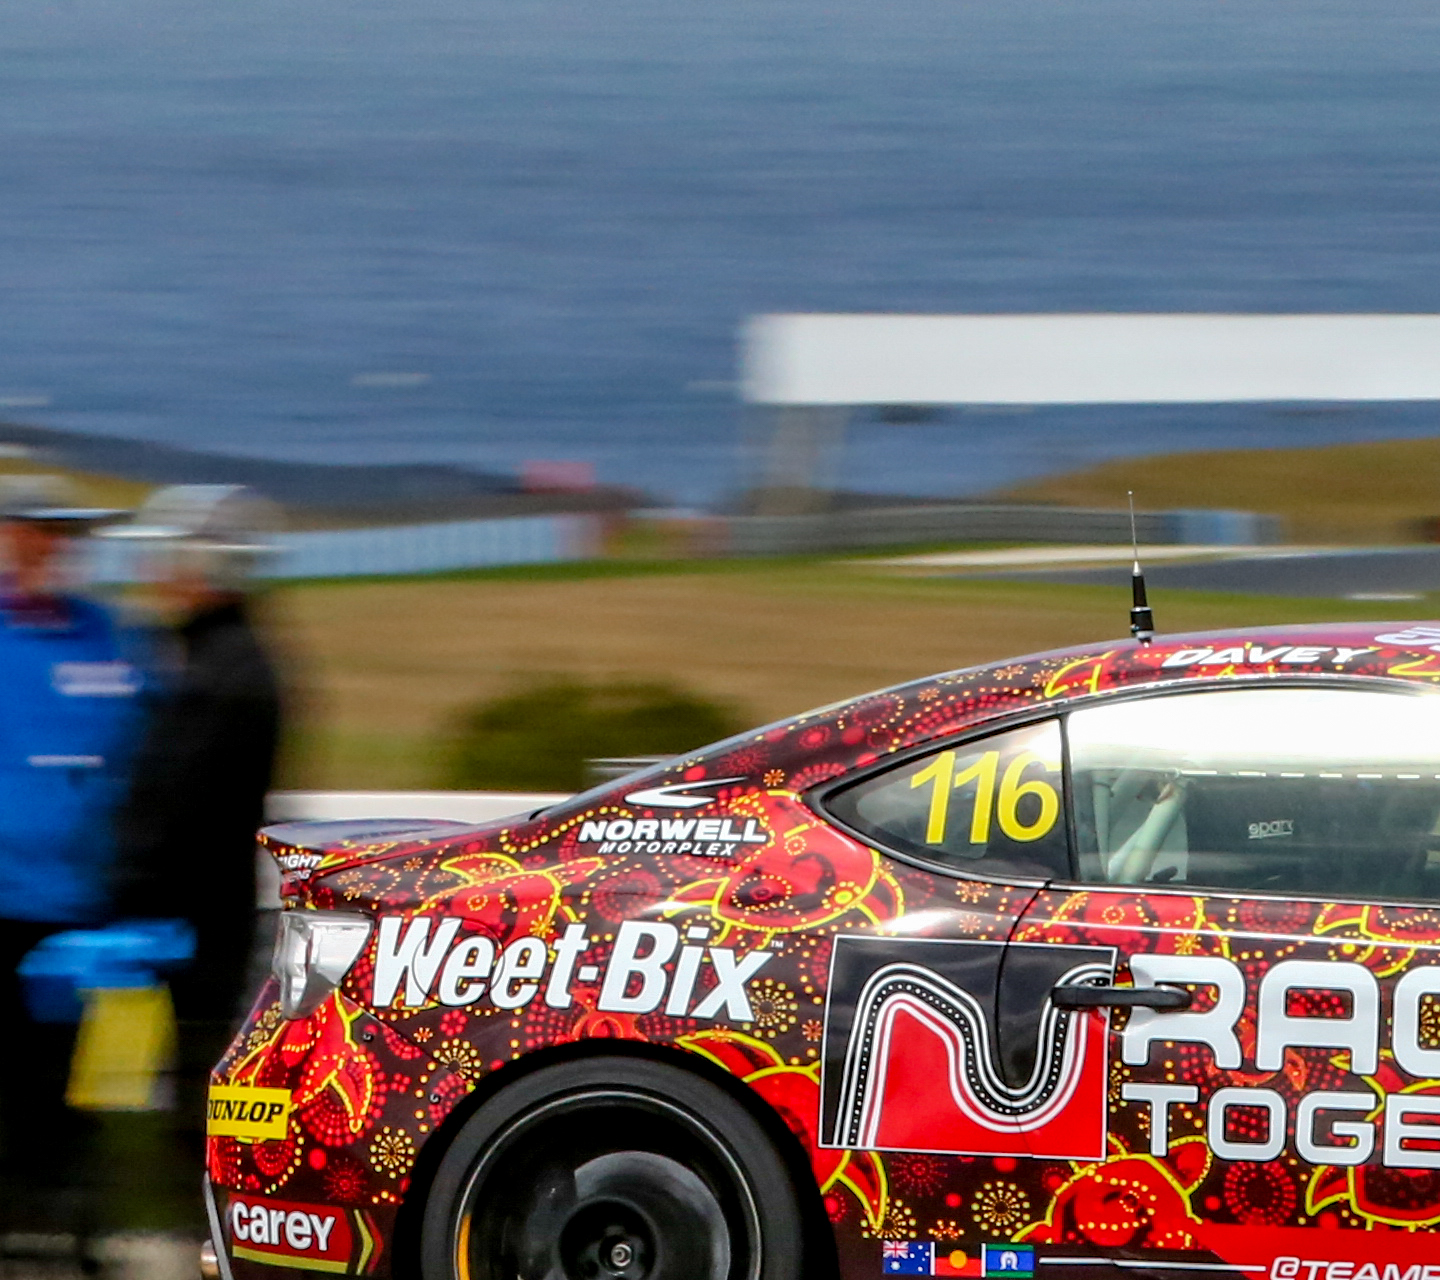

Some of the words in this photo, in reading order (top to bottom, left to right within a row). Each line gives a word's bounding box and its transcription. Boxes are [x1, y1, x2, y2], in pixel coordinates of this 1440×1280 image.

[1162, 646, 1380, 667] DAVEY
[910, 750, 1061, 844] 116
[578, 819, 767, 842] NORWELL
[598, 841, 736, 856] MOTORPLEX
[372, 917, 774, 1021] Weet-Bix
